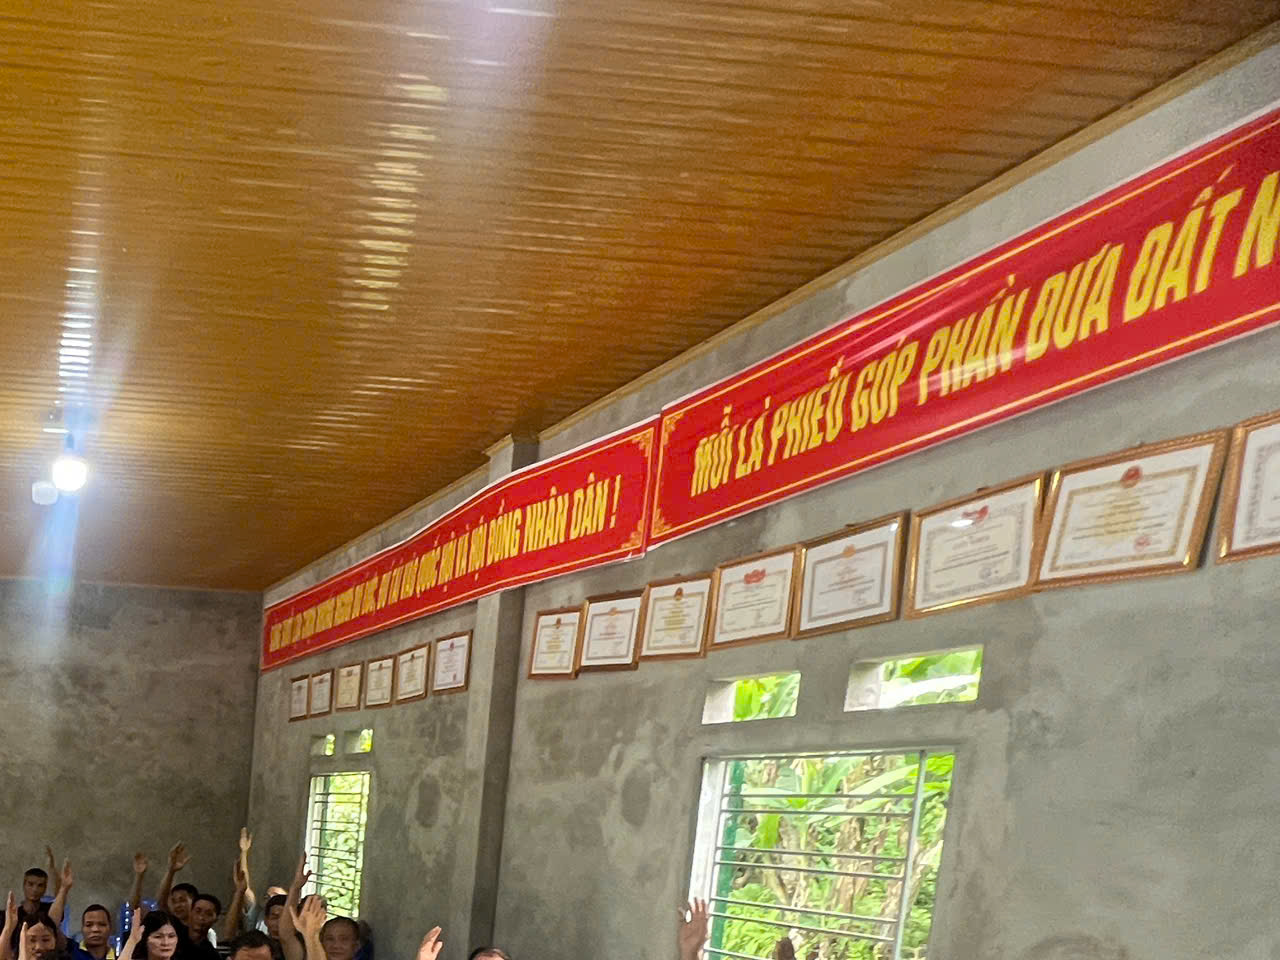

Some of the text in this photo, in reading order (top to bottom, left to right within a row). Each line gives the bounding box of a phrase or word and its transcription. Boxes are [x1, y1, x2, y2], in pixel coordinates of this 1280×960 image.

[691, 404, 739, 497] MỖI
[735, 395, 770, 480] LÁ
[767, 355, 853, 466] PHIẾU
[851, 335, 918, 432] GÓP
[917, 273, 1031, 407] PHẦN
[1024, 243, 1125, 364] ĐƯA
[1122, 163, 1246, 323] ĐẤT
[523, 485, 569, 554] NHÂN
[569, 472, 610, 541] DÂN
